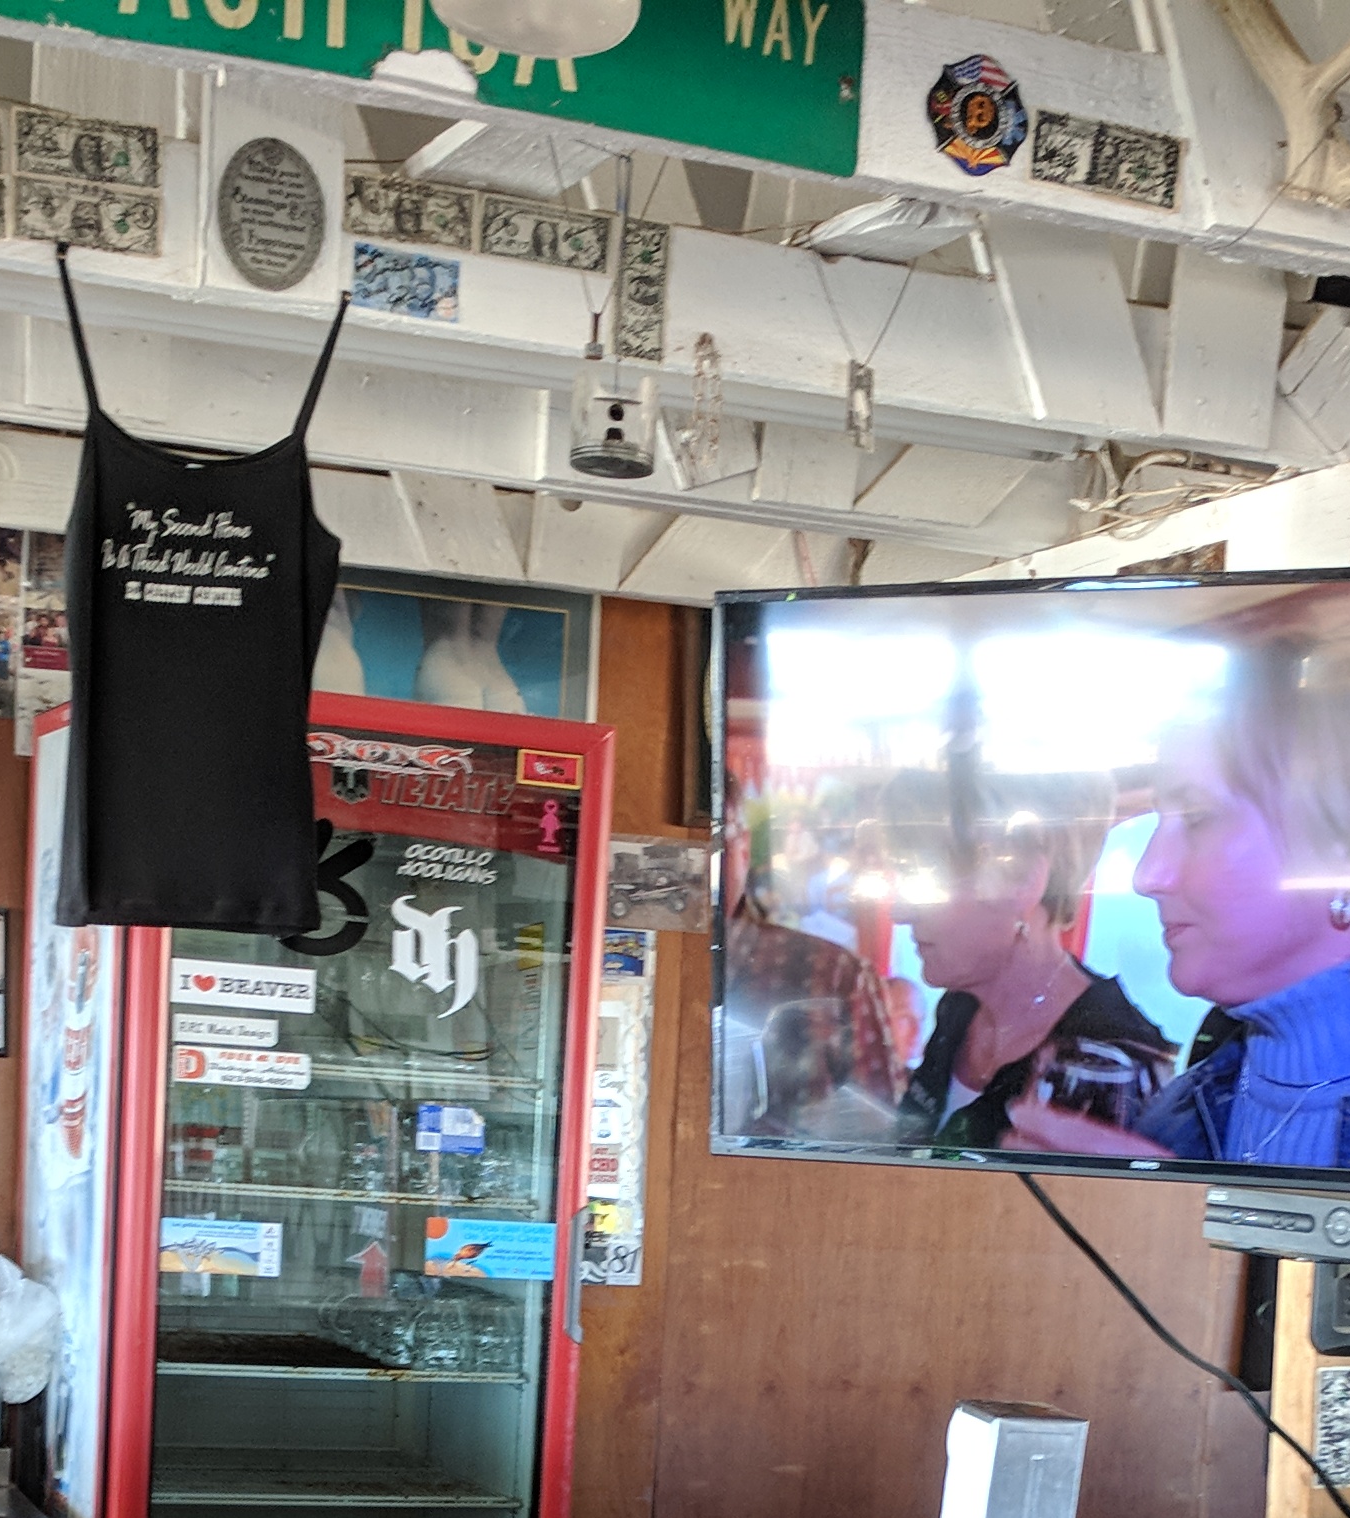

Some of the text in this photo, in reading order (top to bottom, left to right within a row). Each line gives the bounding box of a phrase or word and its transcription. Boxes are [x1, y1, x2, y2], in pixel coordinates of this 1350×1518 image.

[721, 0, 827, 66] WAY
[404, 843, 494, 867] OCOTILLO
[396, 858, 499, 886] HOOLIGANS
[180, 974, 311, 1001] I BEAVER
